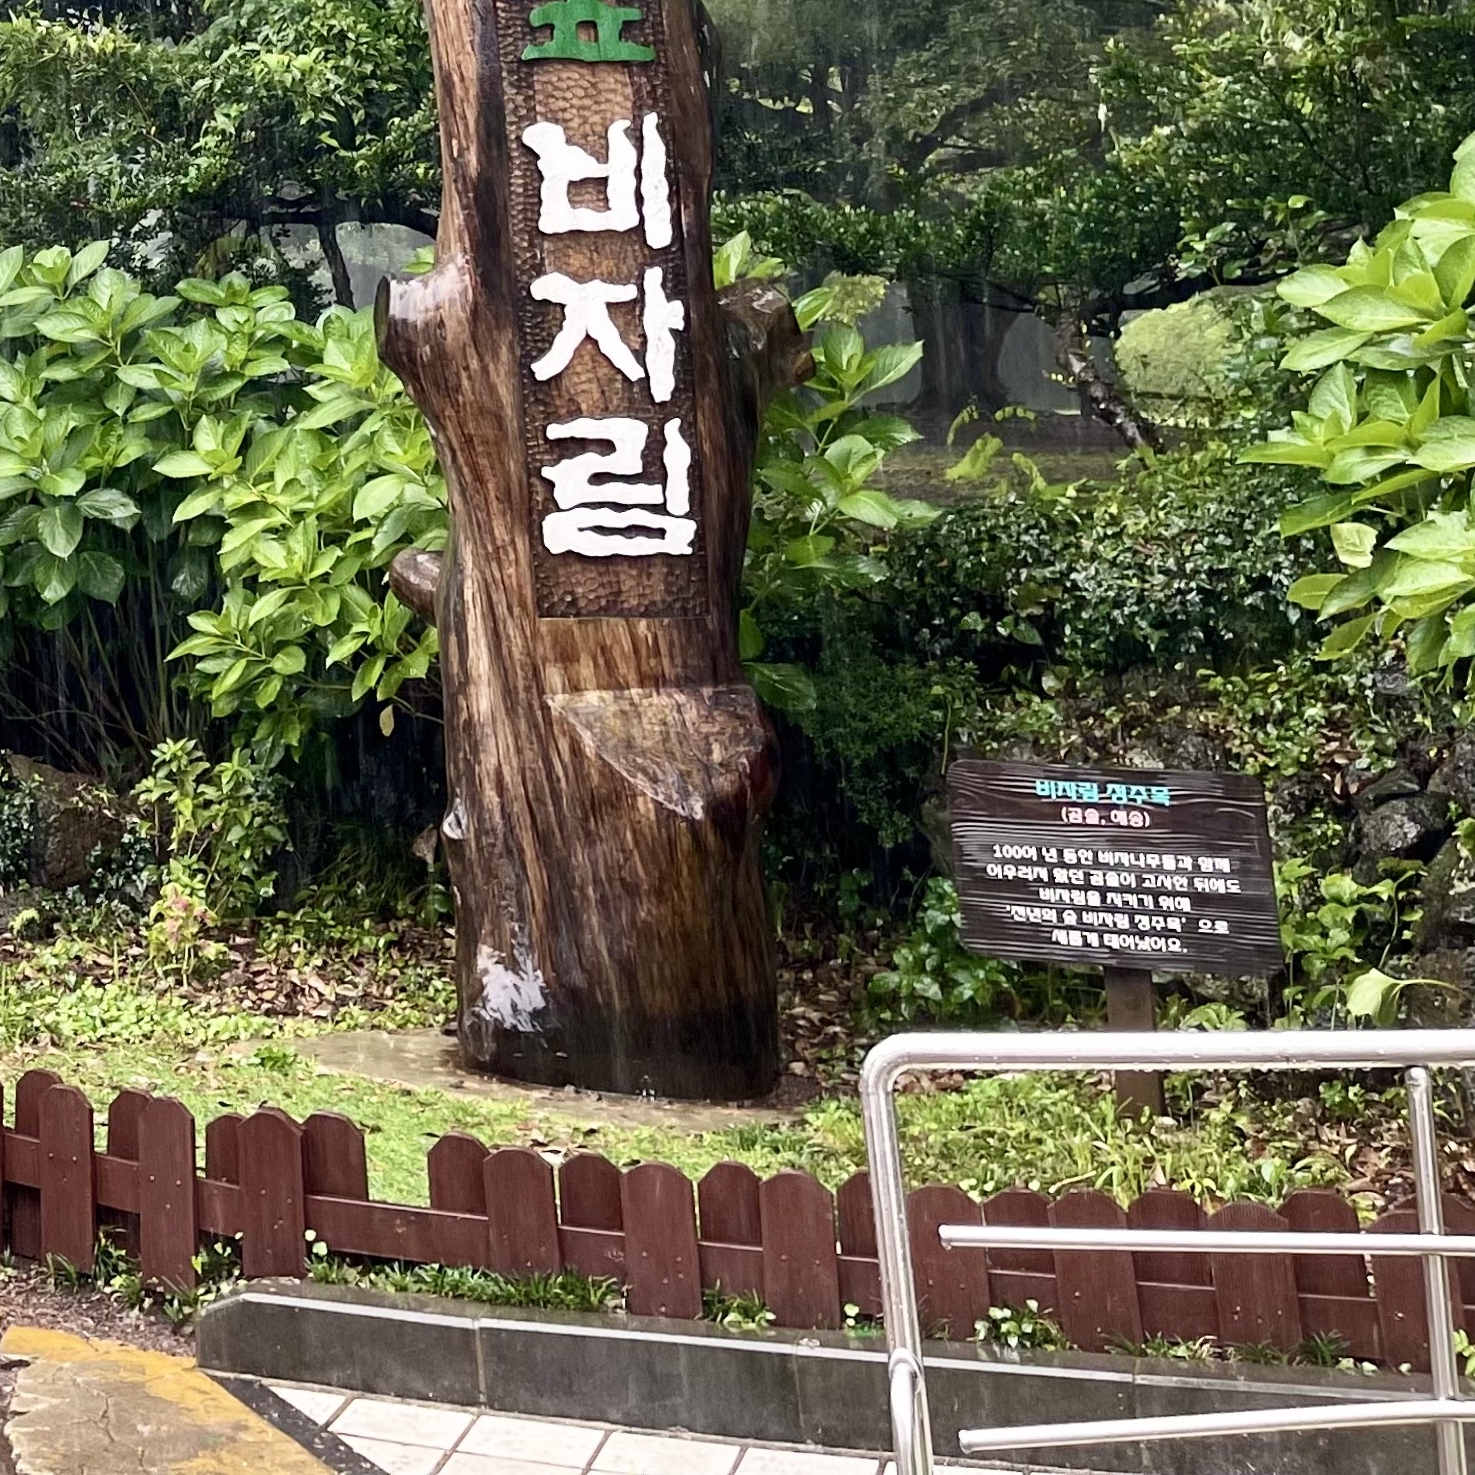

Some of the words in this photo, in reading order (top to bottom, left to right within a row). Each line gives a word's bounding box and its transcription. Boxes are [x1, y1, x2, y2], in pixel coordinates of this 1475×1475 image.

[523, 112, 696, 556] 비자림
[1035, 780, 1099, 803] 비자림
[993, 844, 1038, 862] 100여
[1041, 847, 1058, 863] 년
[1063, 849, 1094, 865] 동안
[1097, 850, 1193, 872] 비자나무들과
[1197, 856, 1231, 874] 함께
[1141, 874, 1188, 892] 고사한
[1193, 877, 1242, 894] 뒤에도
[1038, 887, 1101, 907] 비자림을
[1106, 892, 1155, 910] 지키기
[1158, 895, 1191, 912] 위해
[1062, 909, 1078, 926] 숲
[1082, 911, 1130, 930] 비자림
[1197, 919, 1230, 935] 으로
[1051, 929, 1100, 948] 새롭게
[1103, 933, 1188, 954] 태어났어요.
